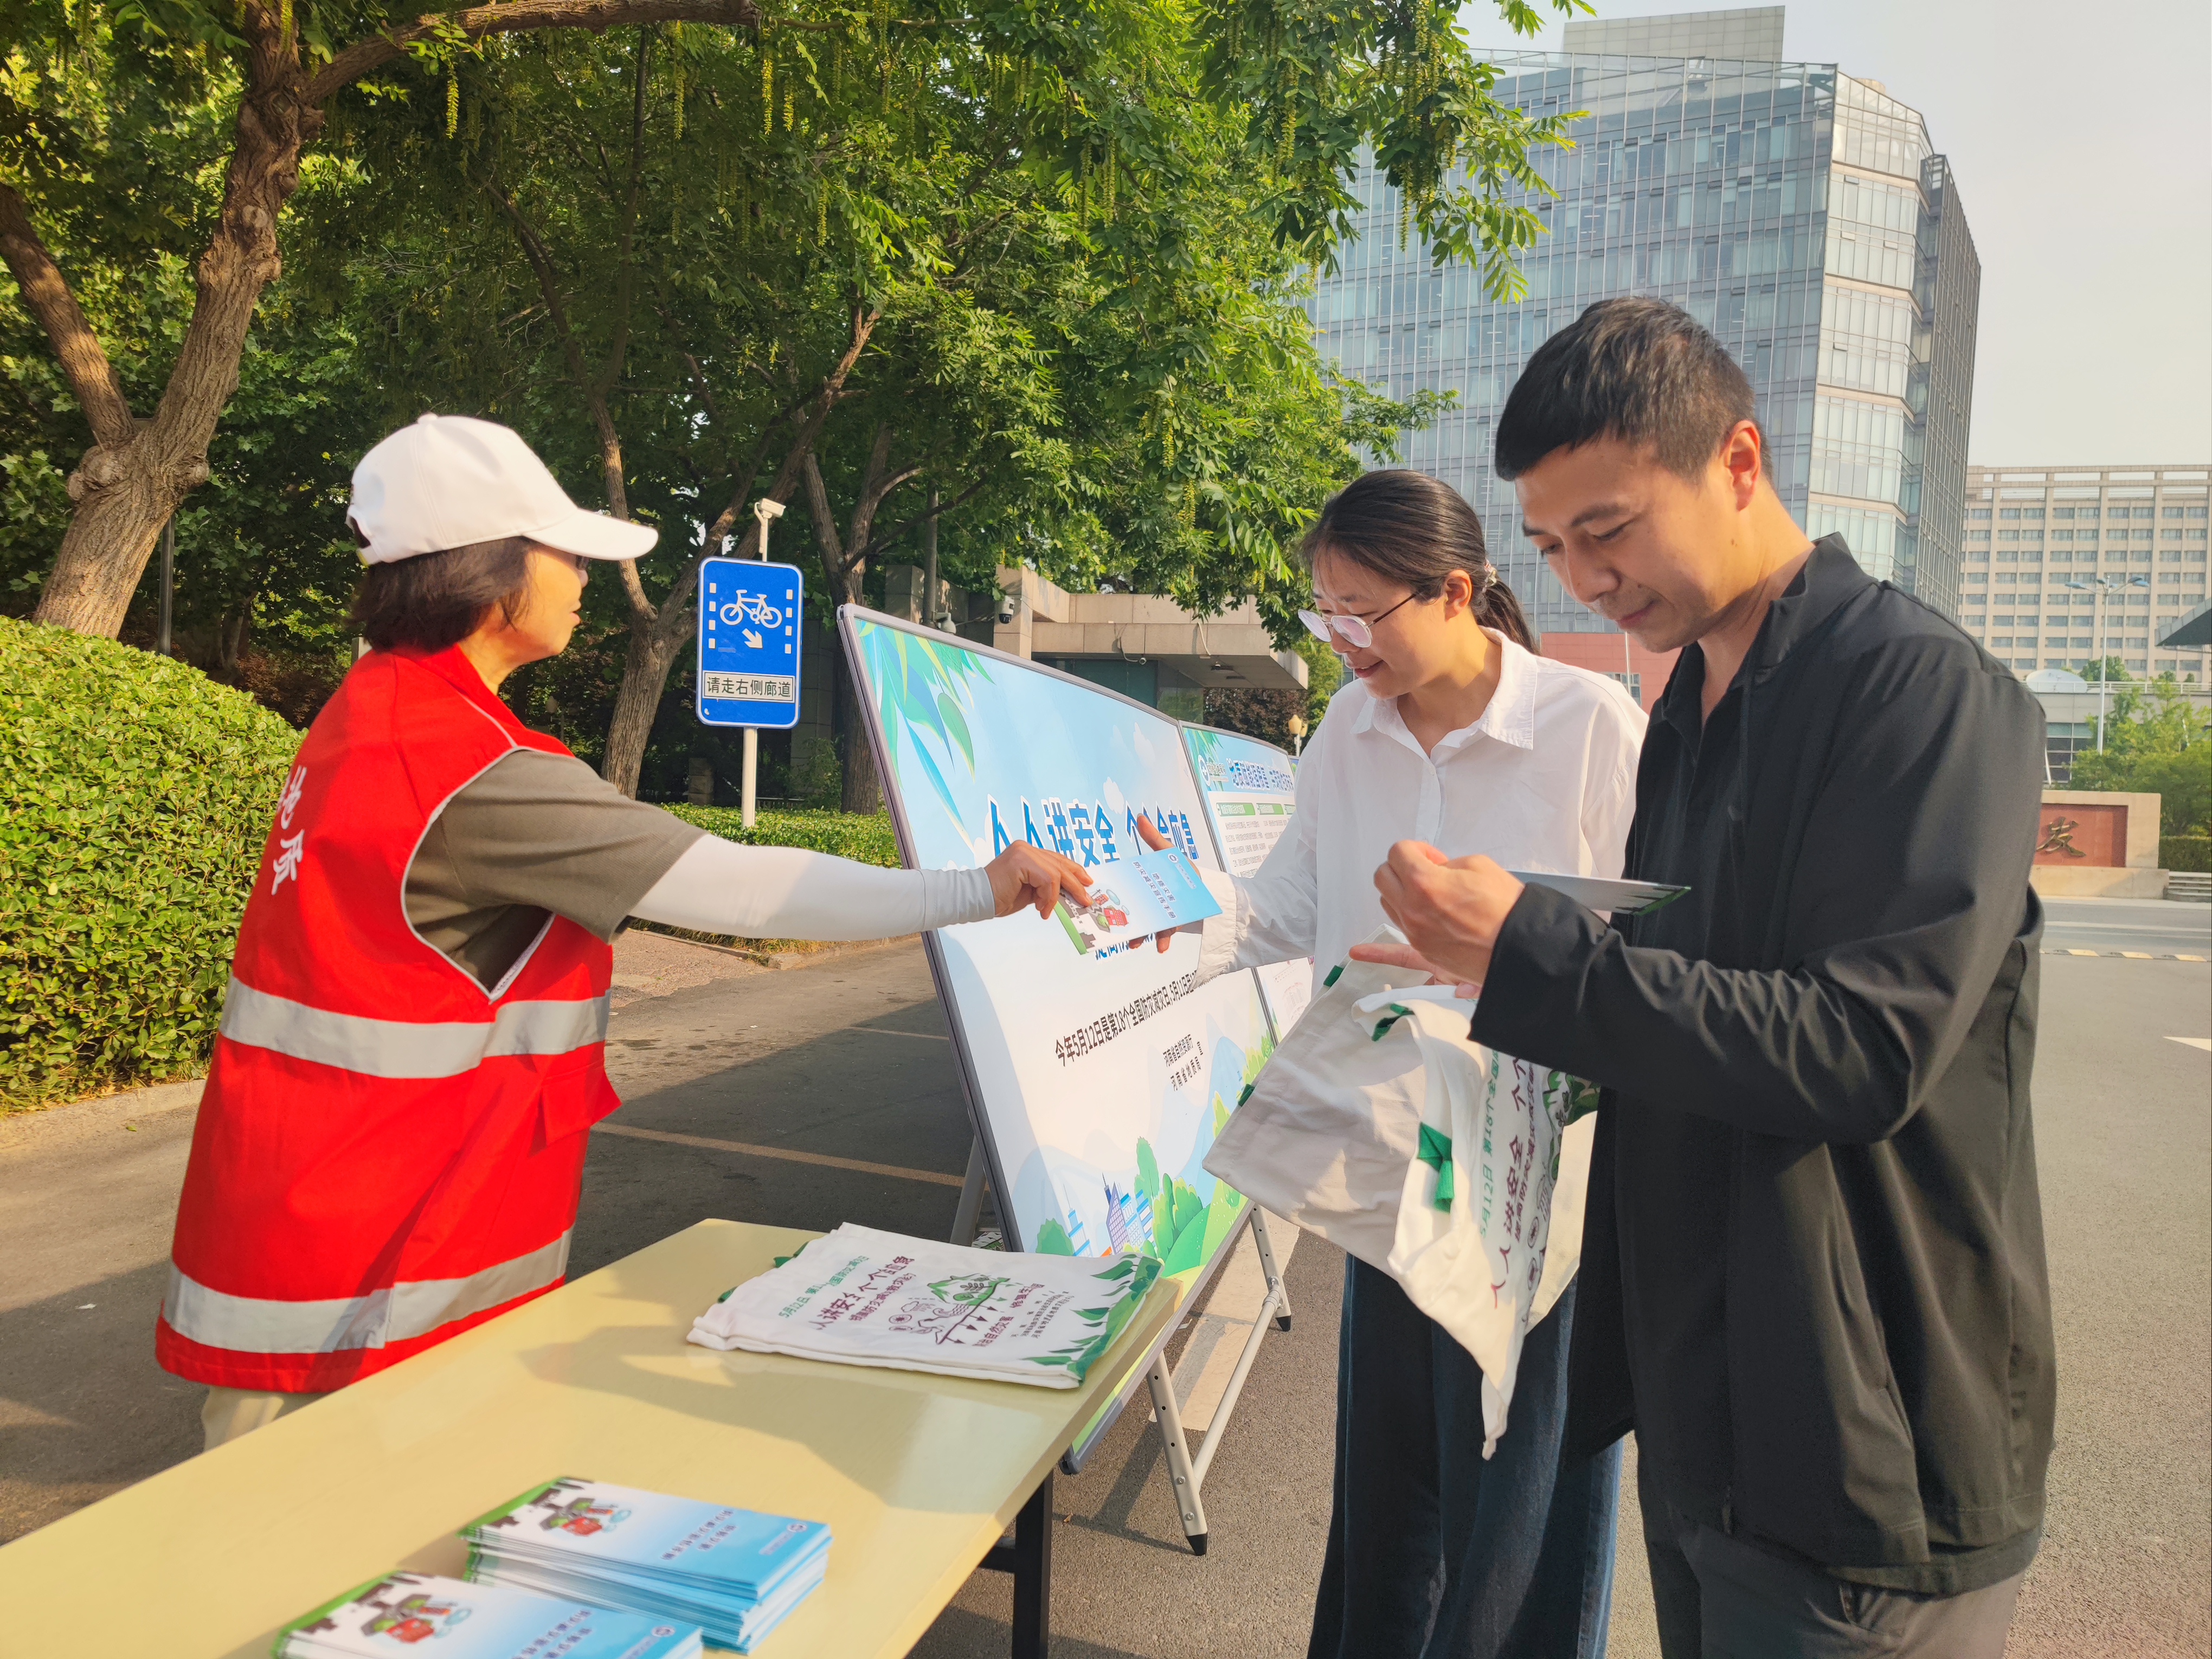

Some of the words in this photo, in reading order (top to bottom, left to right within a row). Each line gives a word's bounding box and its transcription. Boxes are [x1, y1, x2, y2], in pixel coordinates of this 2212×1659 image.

[707, 677, 791, 698] 请走右侧廊道
[988, 797, 1121, 867] 人人讲安全
[1491, 1133, 1523, 1309] 人人讲安全
